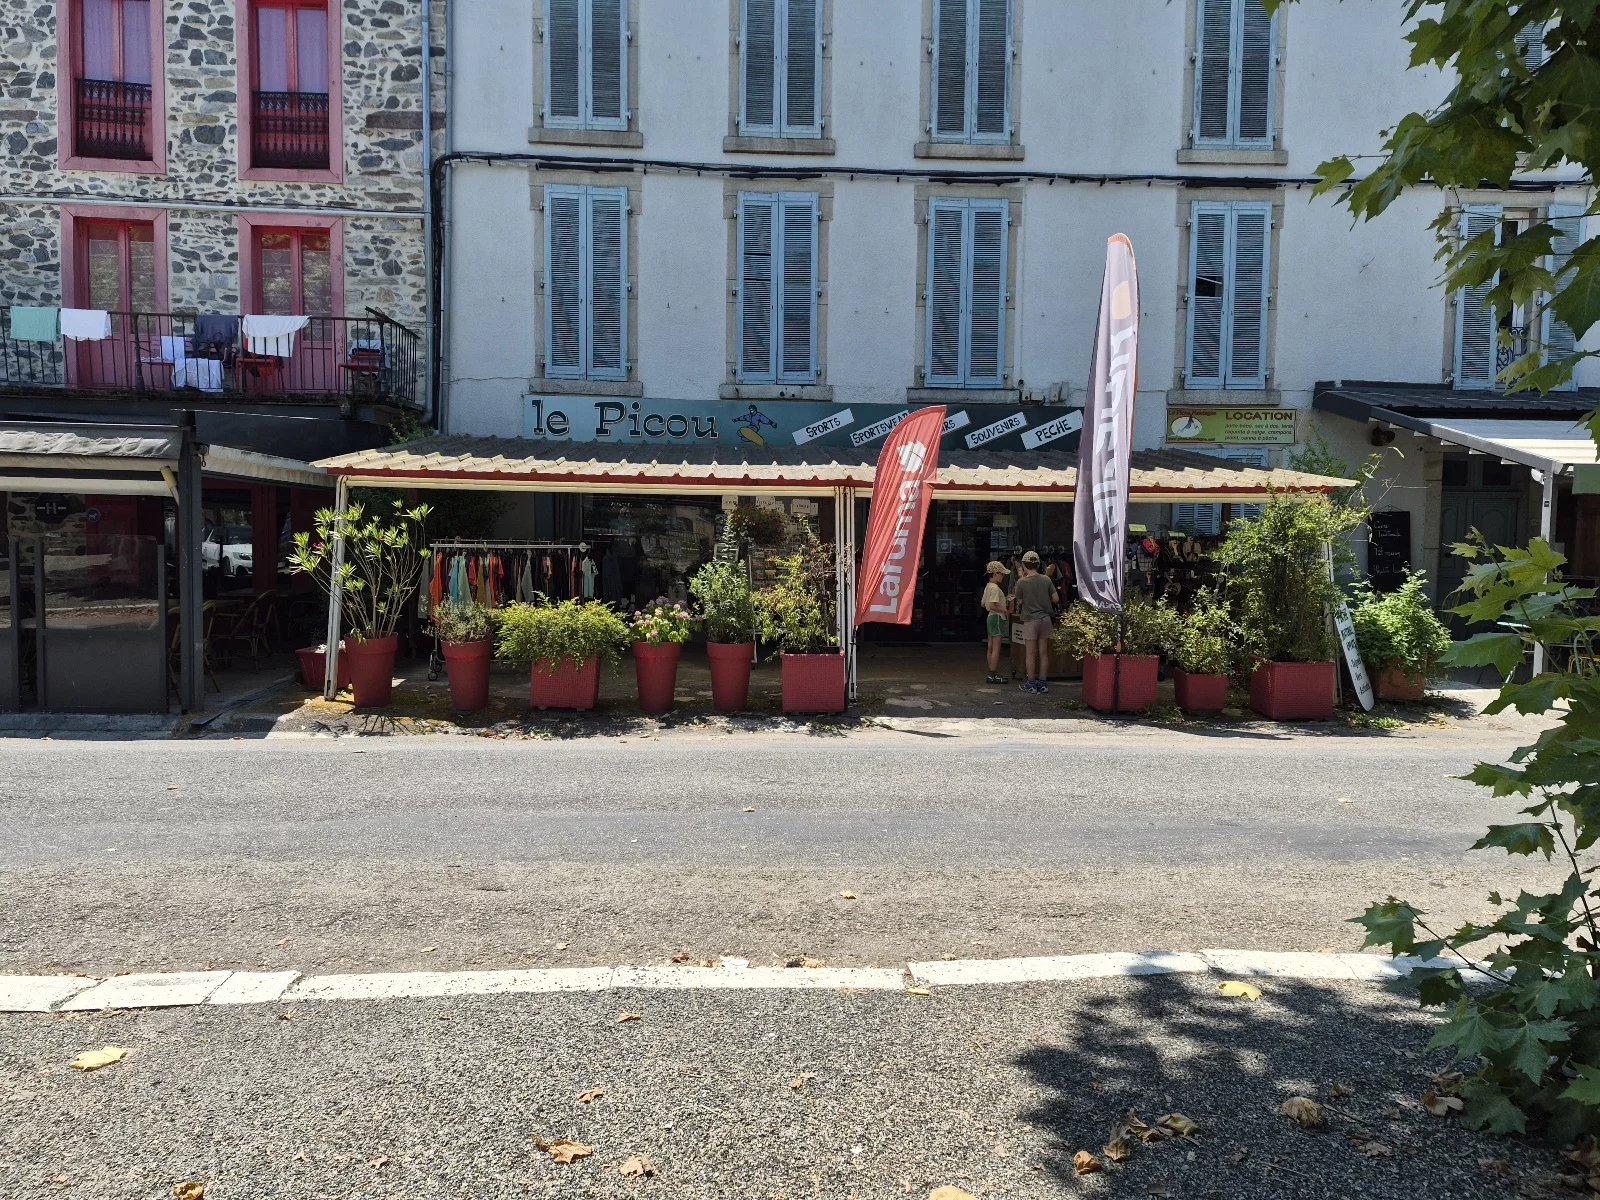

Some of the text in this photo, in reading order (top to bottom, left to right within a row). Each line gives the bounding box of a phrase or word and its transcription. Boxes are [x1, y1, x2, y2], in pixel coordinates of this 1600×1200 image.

[532, 400, 719, 439] le Picou
[1225, 411, 1293, 421] LOCATION
[805, 417, 841, 438] SPORTS
[970, 416, 1021, 445] SOUVENIRS
[1035, 420, 1073, 442] PECHE
